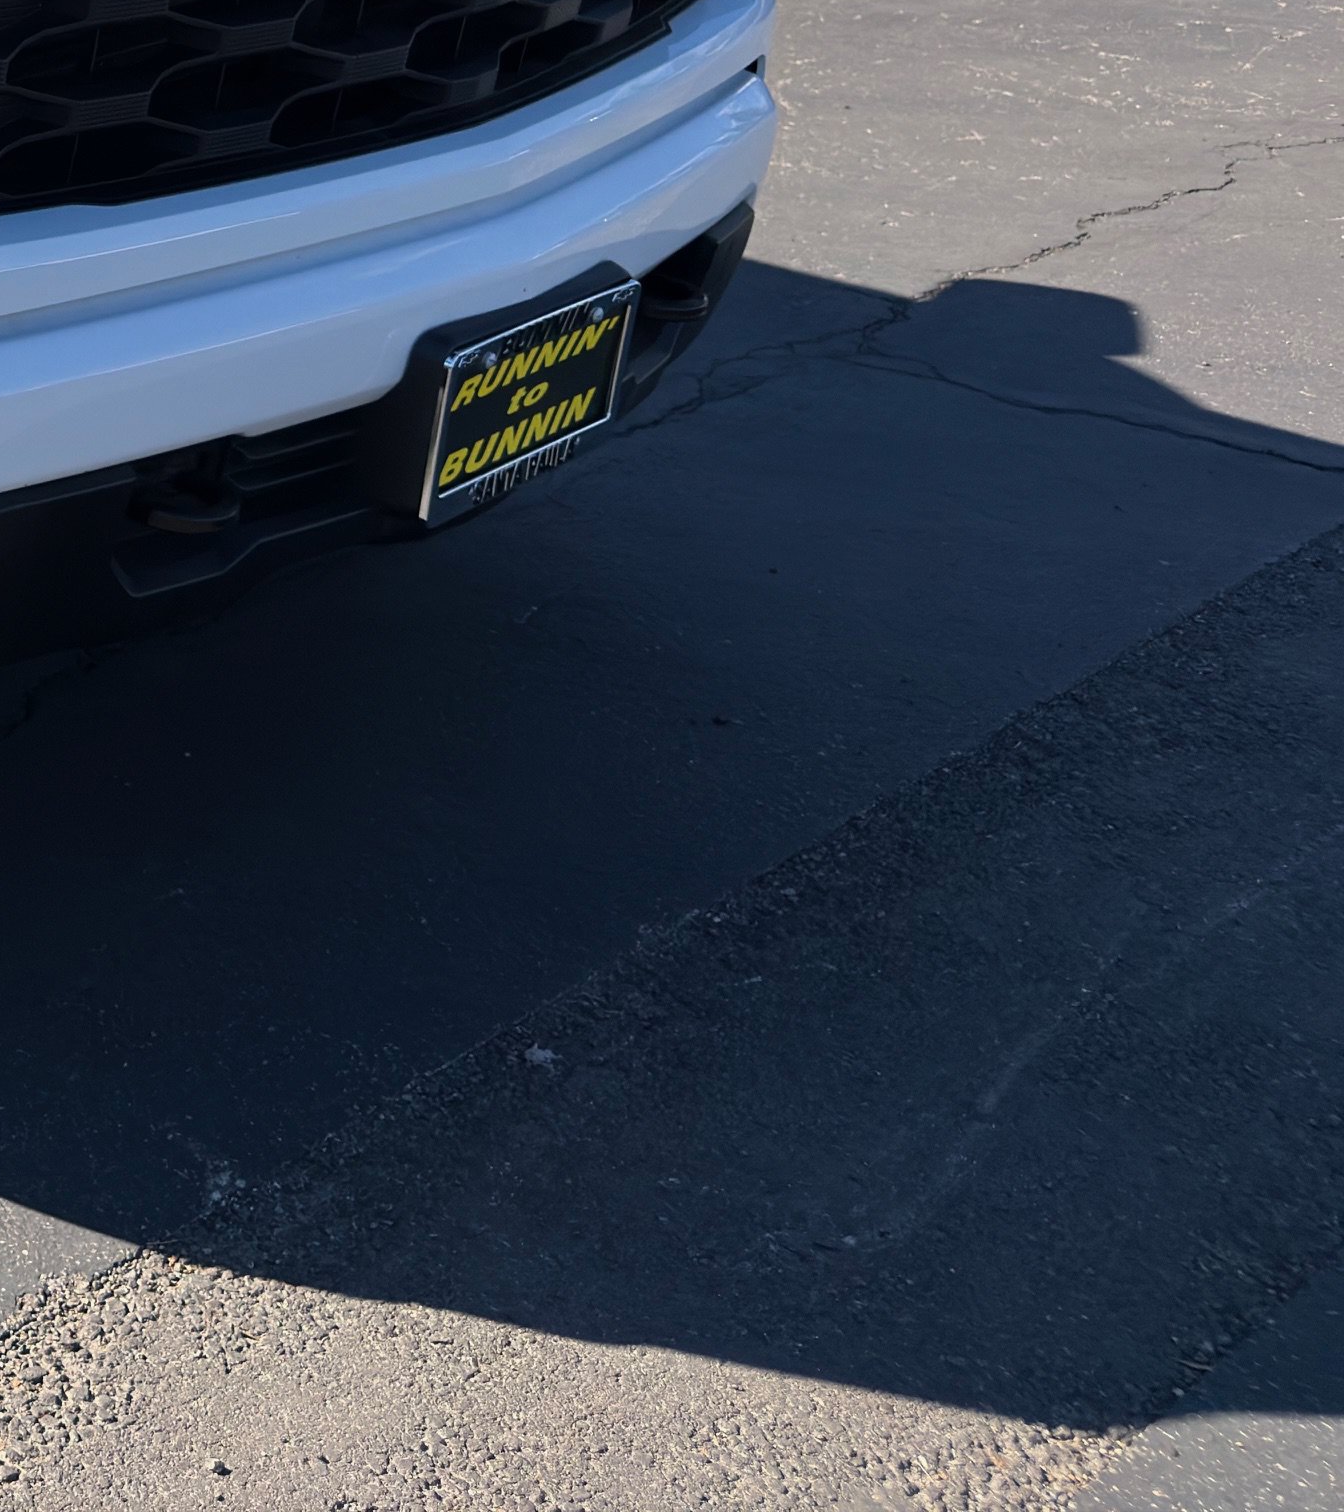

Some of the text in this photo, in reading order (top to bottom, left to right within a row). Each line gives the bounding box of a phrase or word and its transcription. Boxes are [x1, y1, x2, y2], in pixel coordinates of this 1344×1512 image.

[450, 315, 620, 413] RUNNIN'
[507, 381, 550, 416] to
[438, 386, 597, 488] BUNNIN
